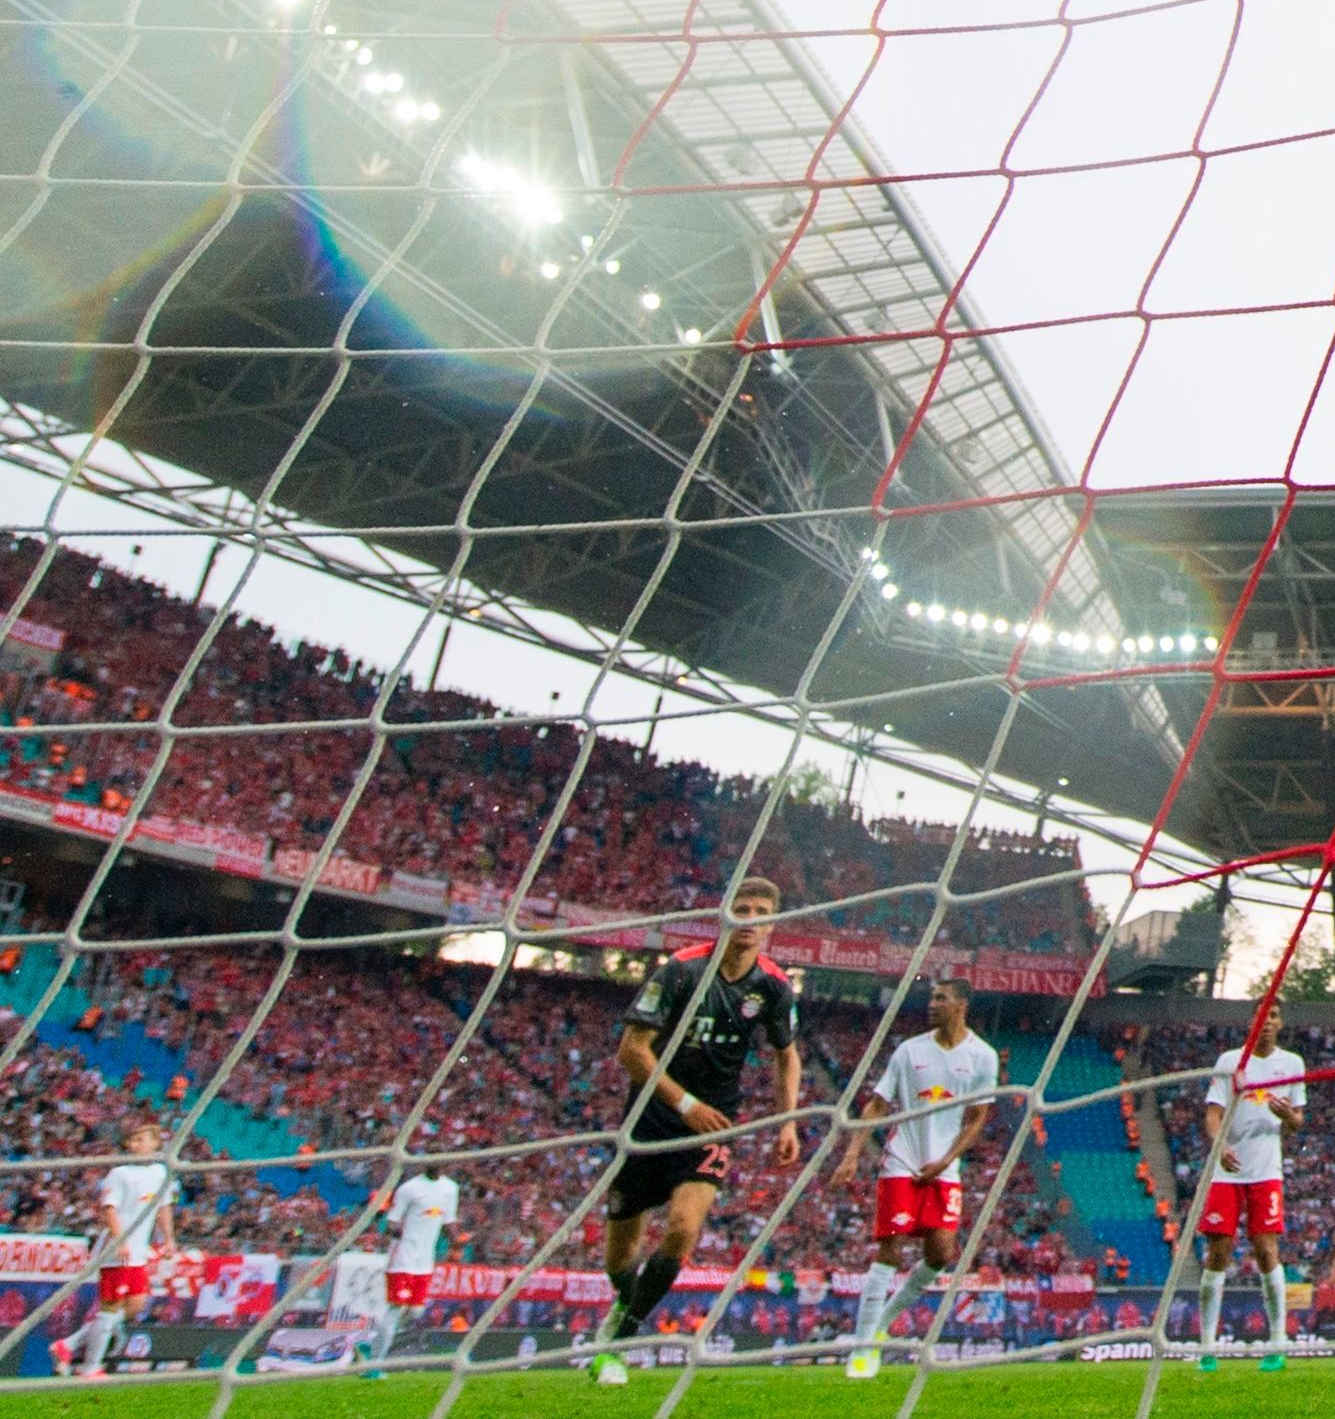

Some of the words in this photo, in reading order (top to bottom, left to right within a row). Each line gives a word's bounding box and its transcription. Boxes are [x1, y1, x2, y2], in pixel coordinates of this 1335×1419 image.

[819, 939, 878, 966] United
[1045, 969, 1106, 998] NEGA
[697, 1143, 731, 1178] 25
